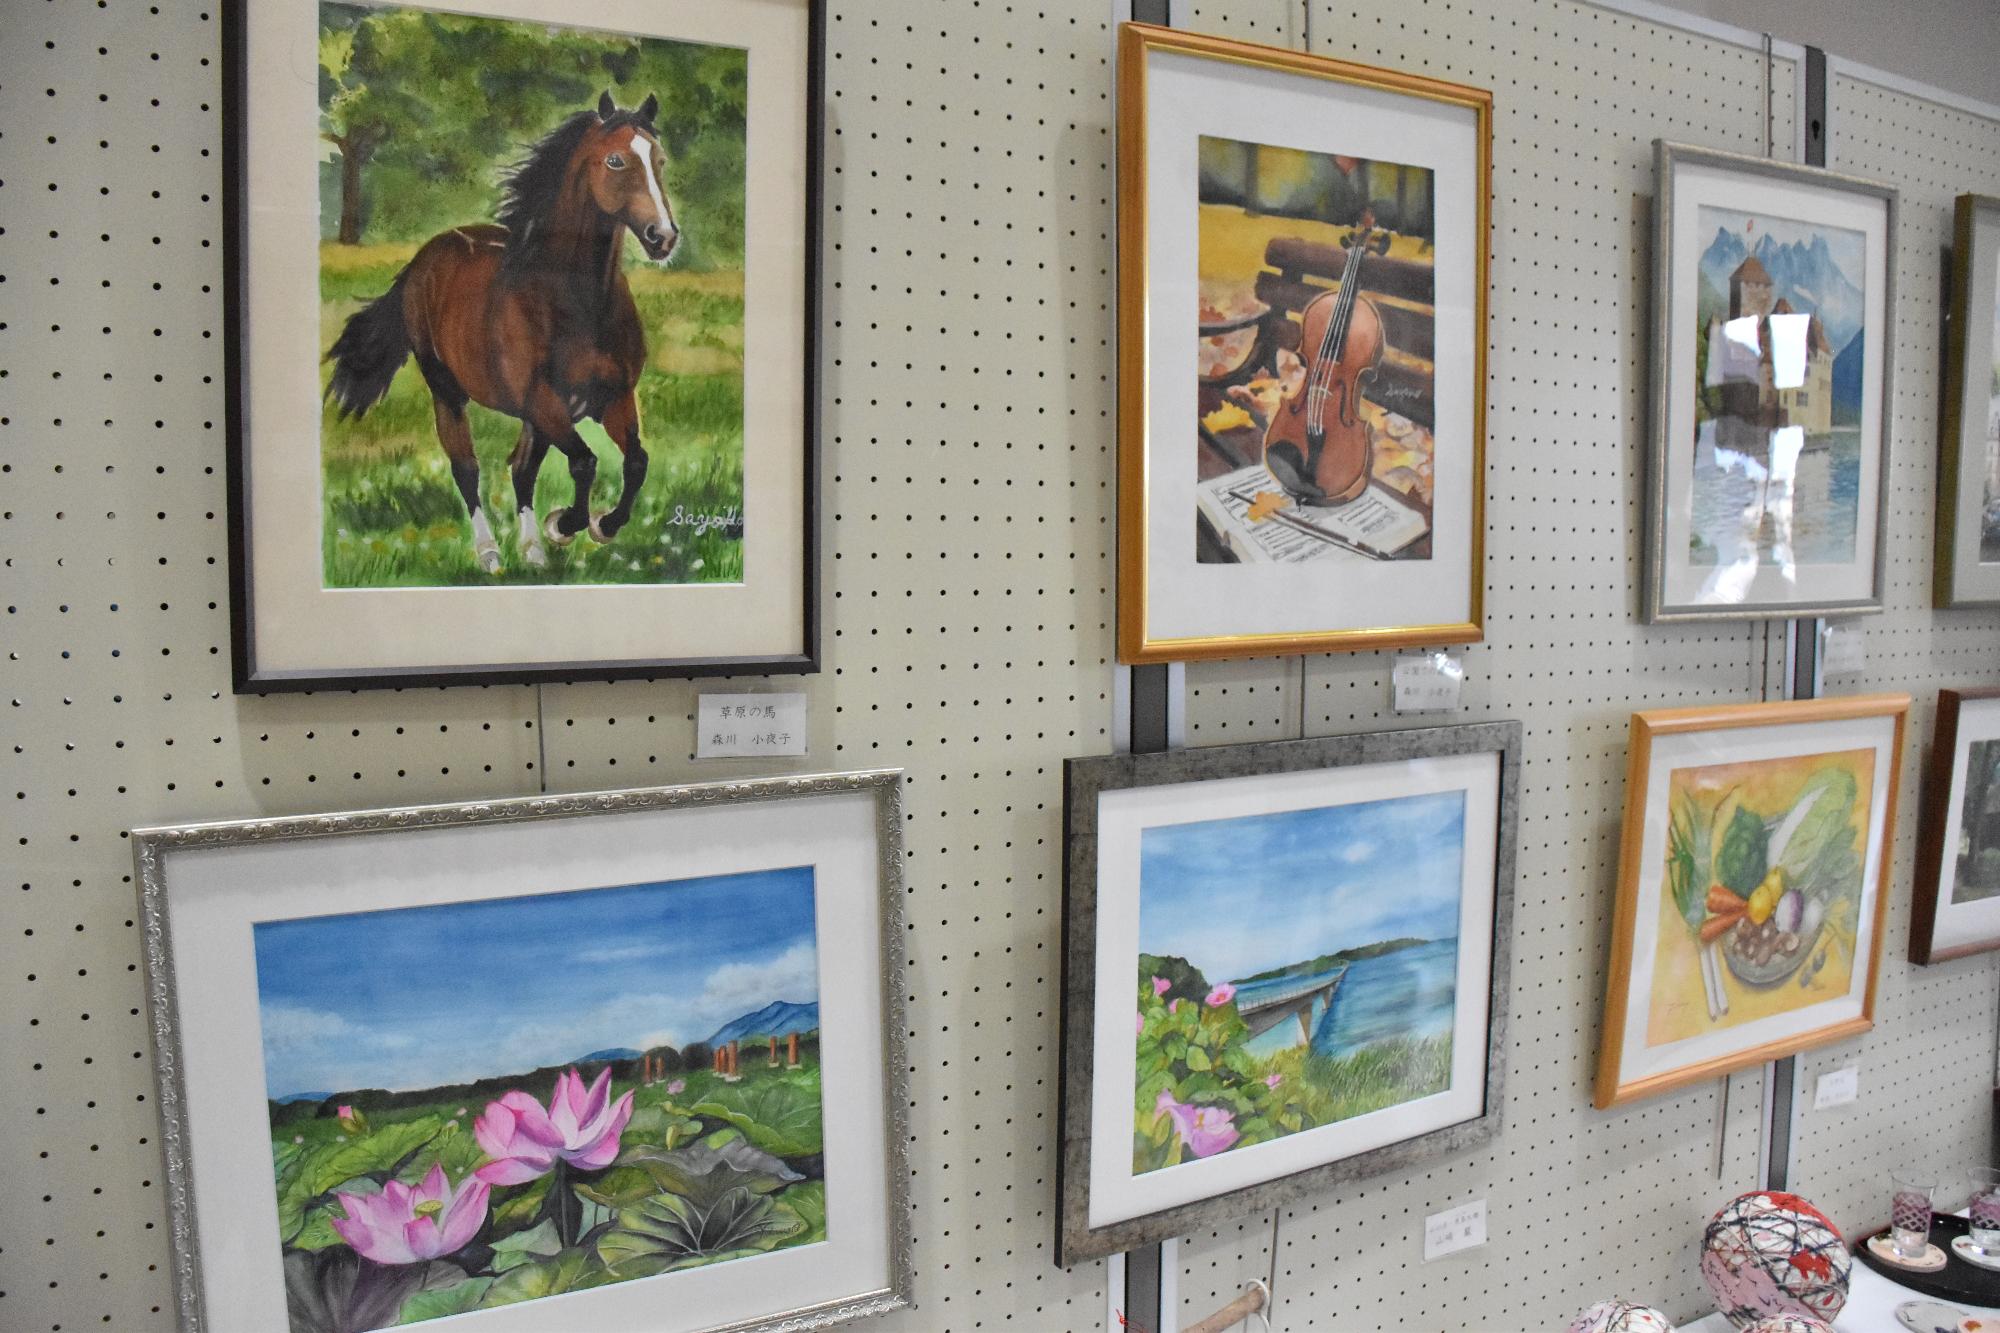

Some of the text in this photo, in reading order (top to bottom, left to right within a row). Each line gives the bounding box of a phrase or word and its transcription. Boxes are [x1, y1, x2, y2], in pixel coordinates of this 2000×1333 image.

[720, 705, 776, 719] 草原の馬
[711, 733, 791, 745] 森川 小夜子
